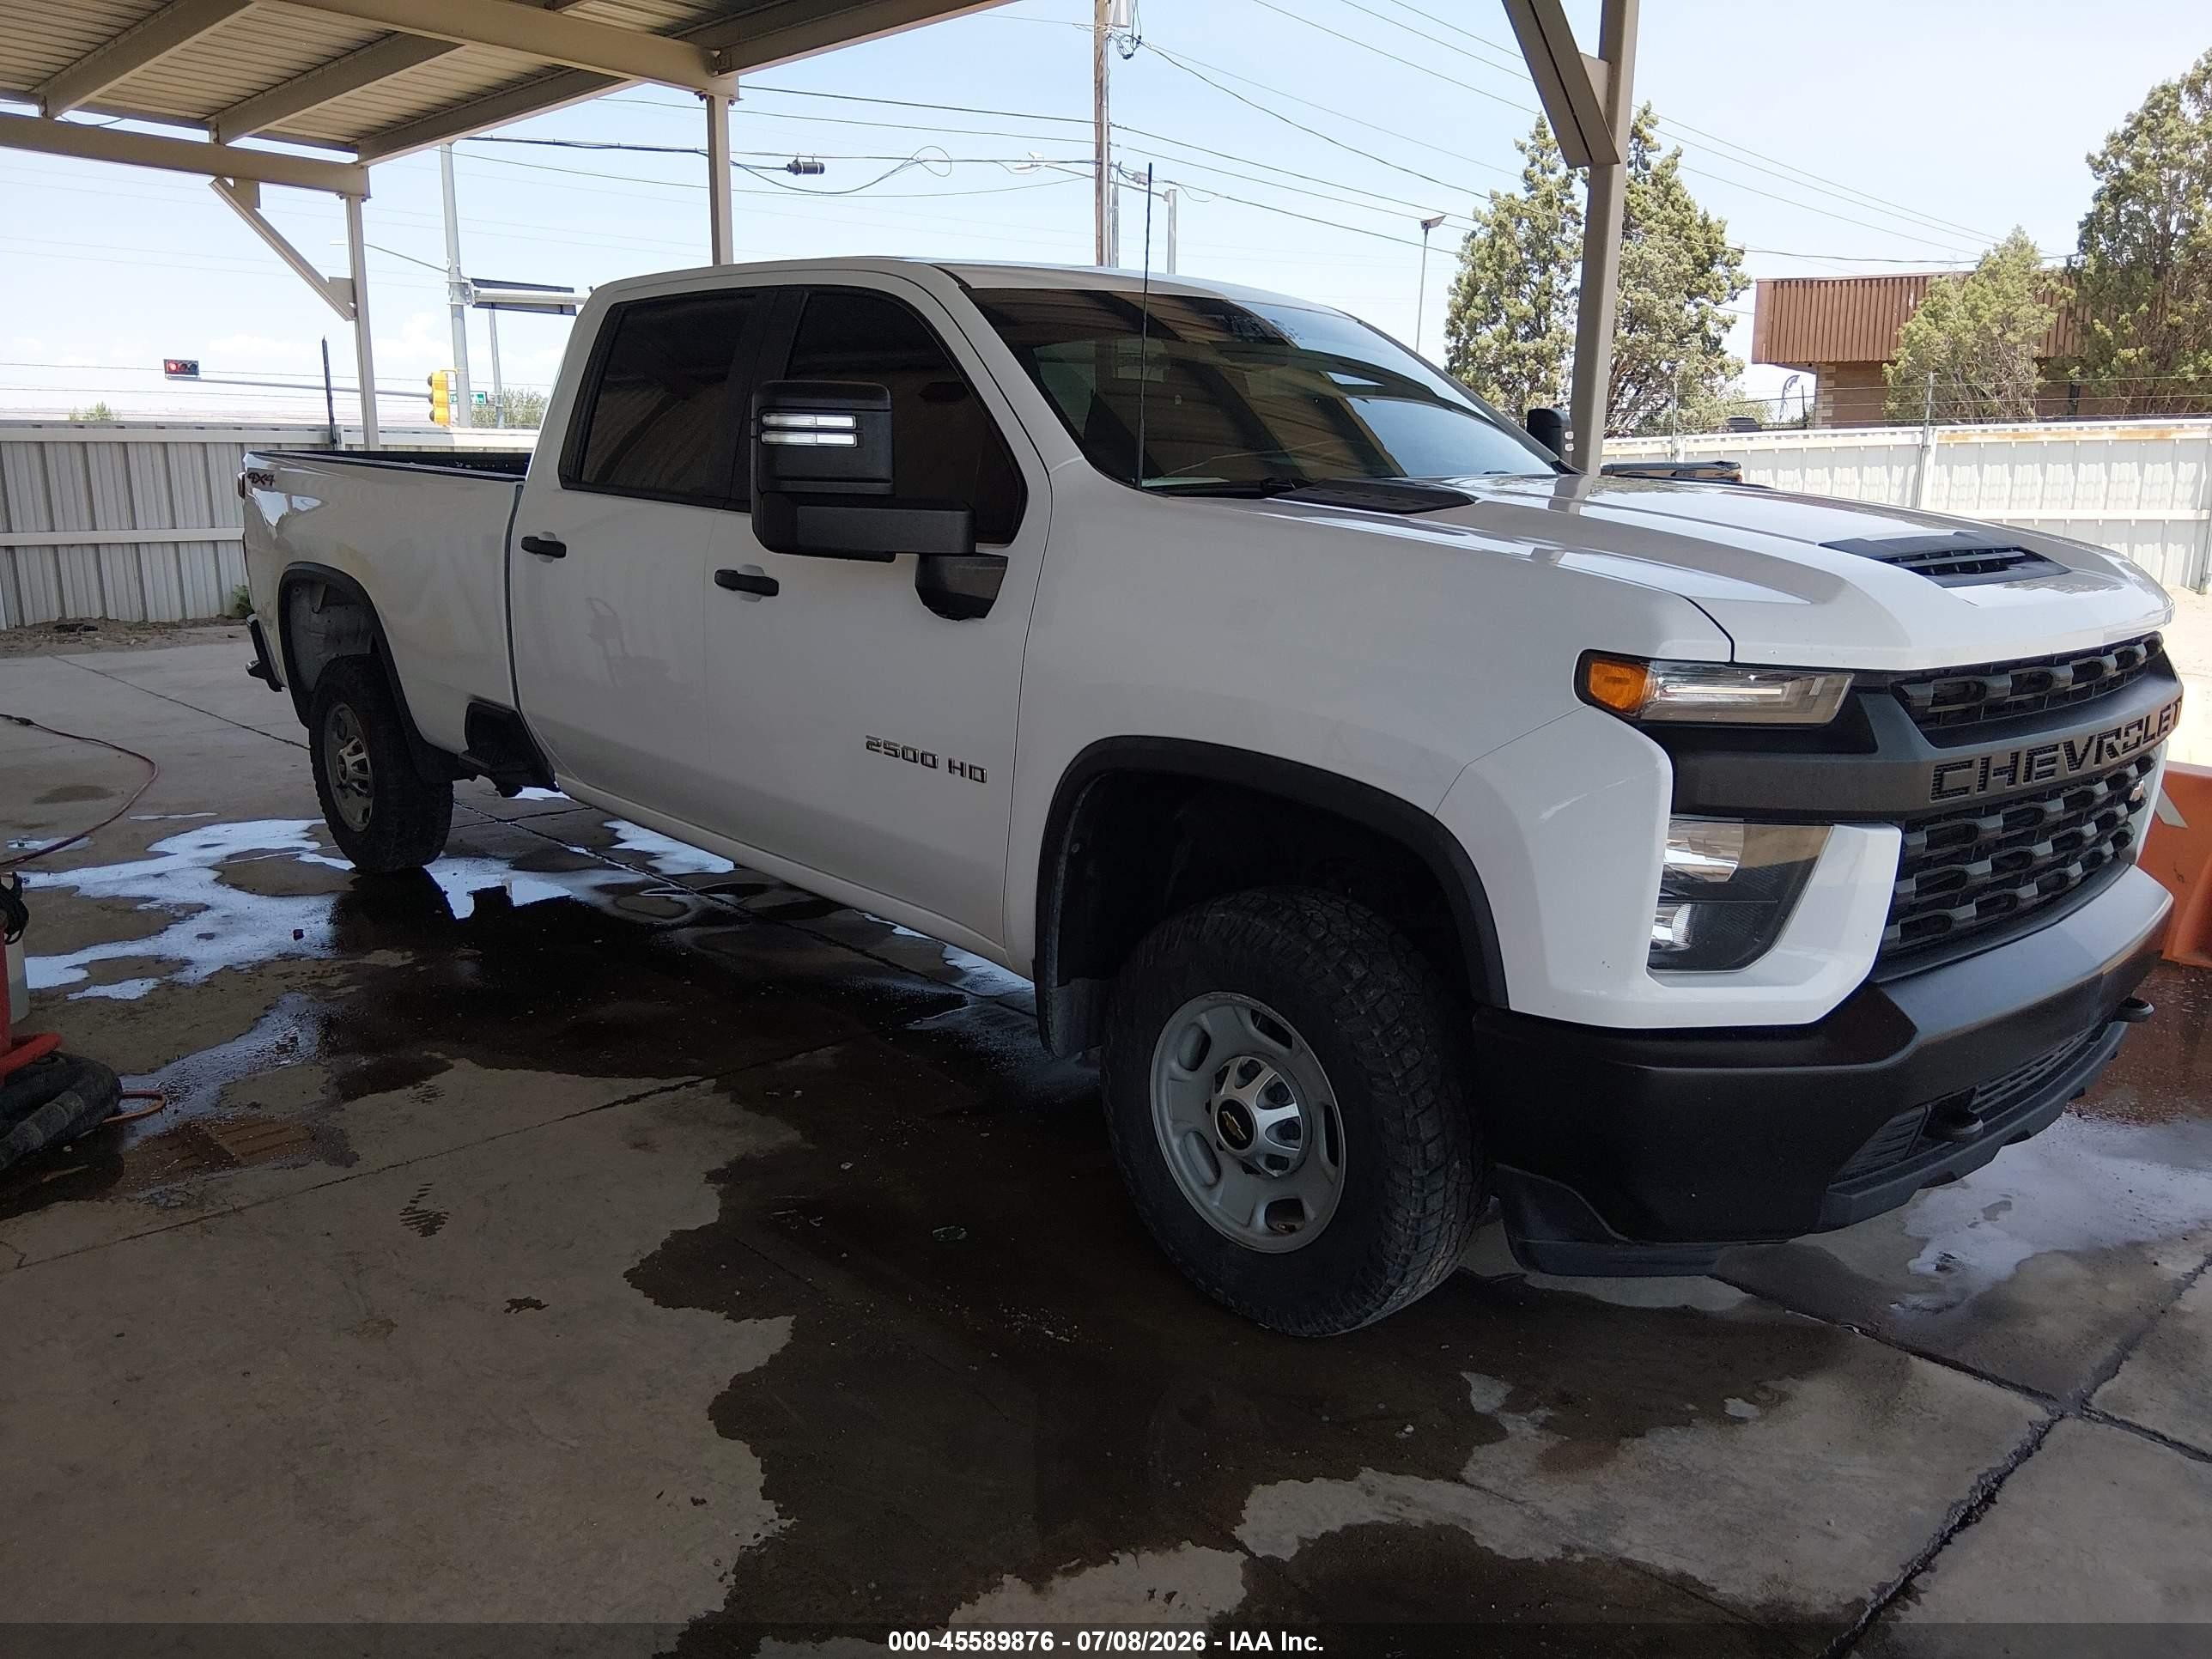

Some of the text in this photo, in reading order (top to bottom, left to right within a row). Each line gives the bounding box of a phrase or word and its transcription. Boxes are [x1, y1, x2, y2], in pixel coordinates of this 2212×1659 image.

[866, 735, 988, 783] 2500 HD
[1930, 696, 2183, 802] CHEVROLET
